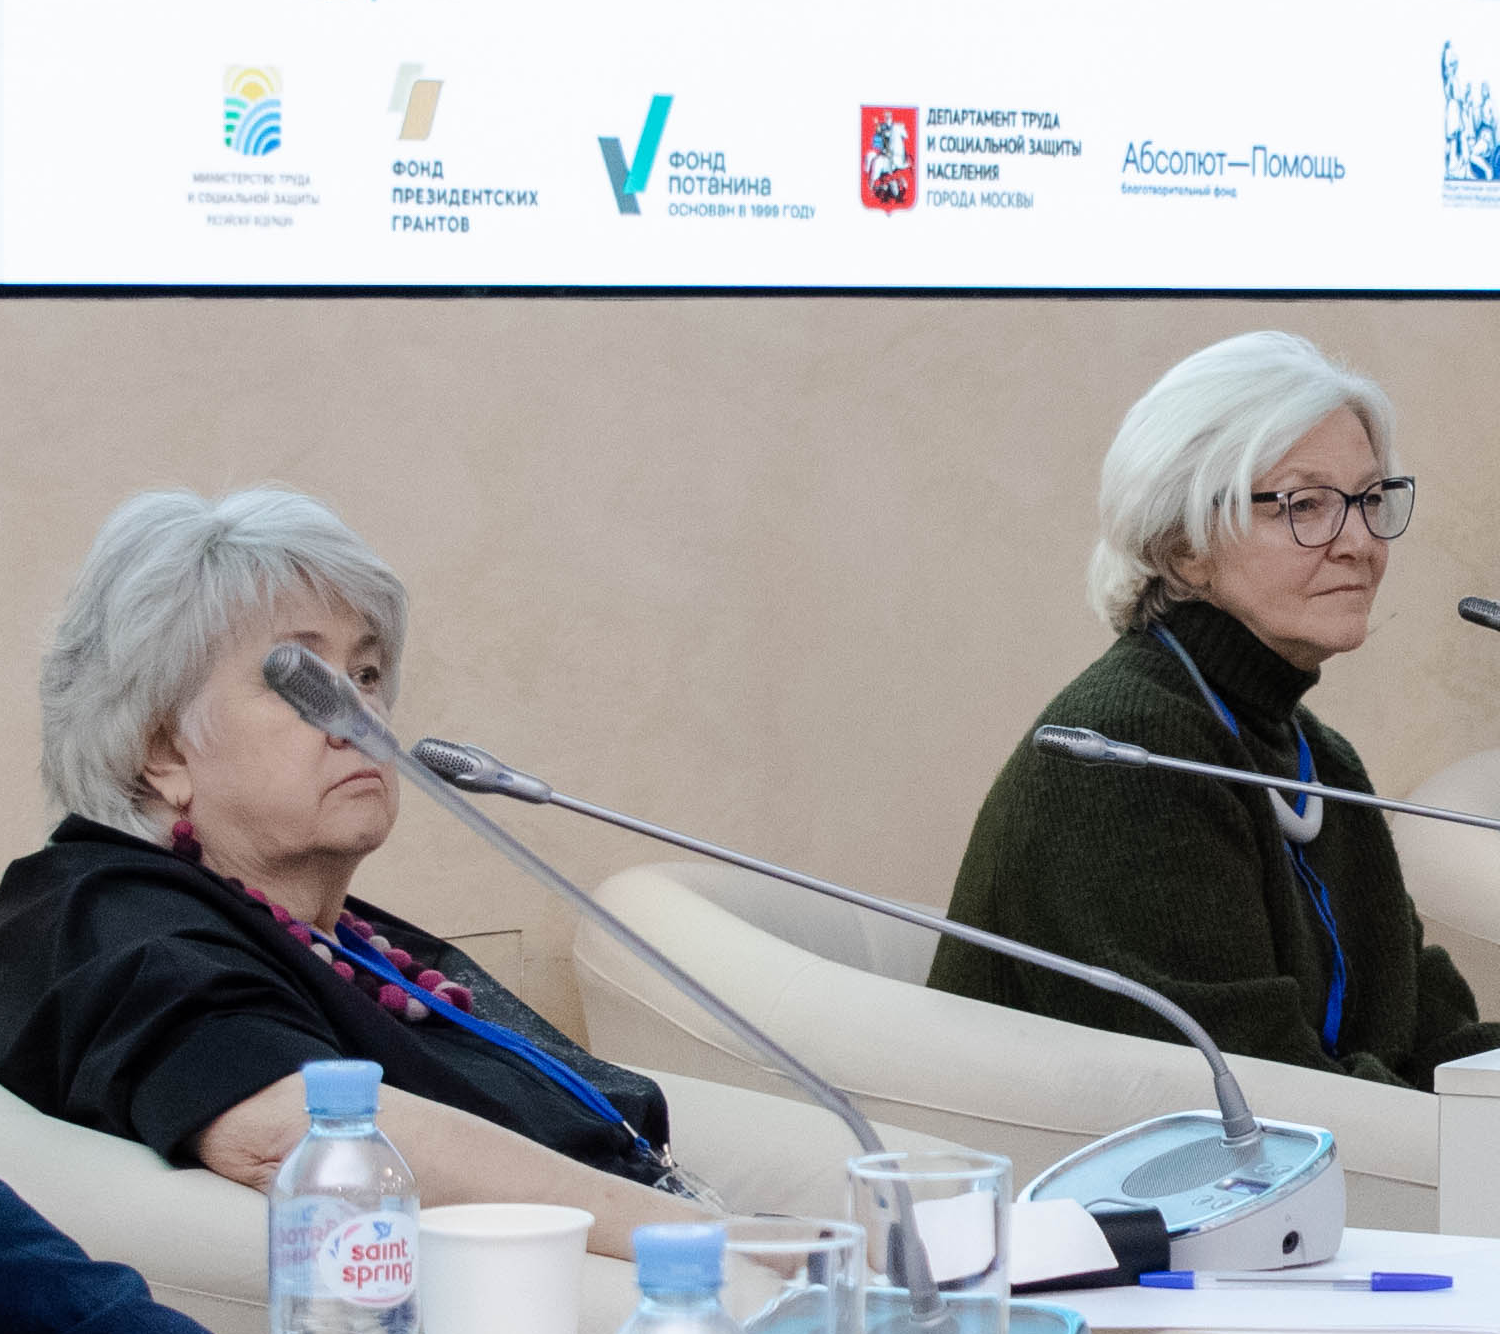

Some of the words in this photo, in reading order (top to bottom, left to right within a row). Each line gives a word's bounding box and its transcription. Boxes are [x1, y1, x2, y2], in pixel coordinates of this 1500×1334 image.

[927, 108, 1017, 127] ДЕПАРТАМЕНТ
[1021, 111, 1060, 130] ТРУДА
[926, 136, 936, 152] И
[940, 134, 1026, 155] СОЦИАЛЬНОЙ
[1029, 138, 1082, 157] ЗАЩИТЫ
[392, 160, 444, 180] ФОНД
[927, 163, 999, 180] НАСЕЛЕНИЯ
[392, 187, 538, 207] ПРЕЗИДЕНТСКИХ
[927, 190, 976, 208] ГОРОДА
[981, 192, 1034, 208] МОСКВЫ
[392, 214, 470, 234] ГРАНТОВ
[352, 1238, 408, 1261] saint
[343, 1261, 412, 1290] spring
